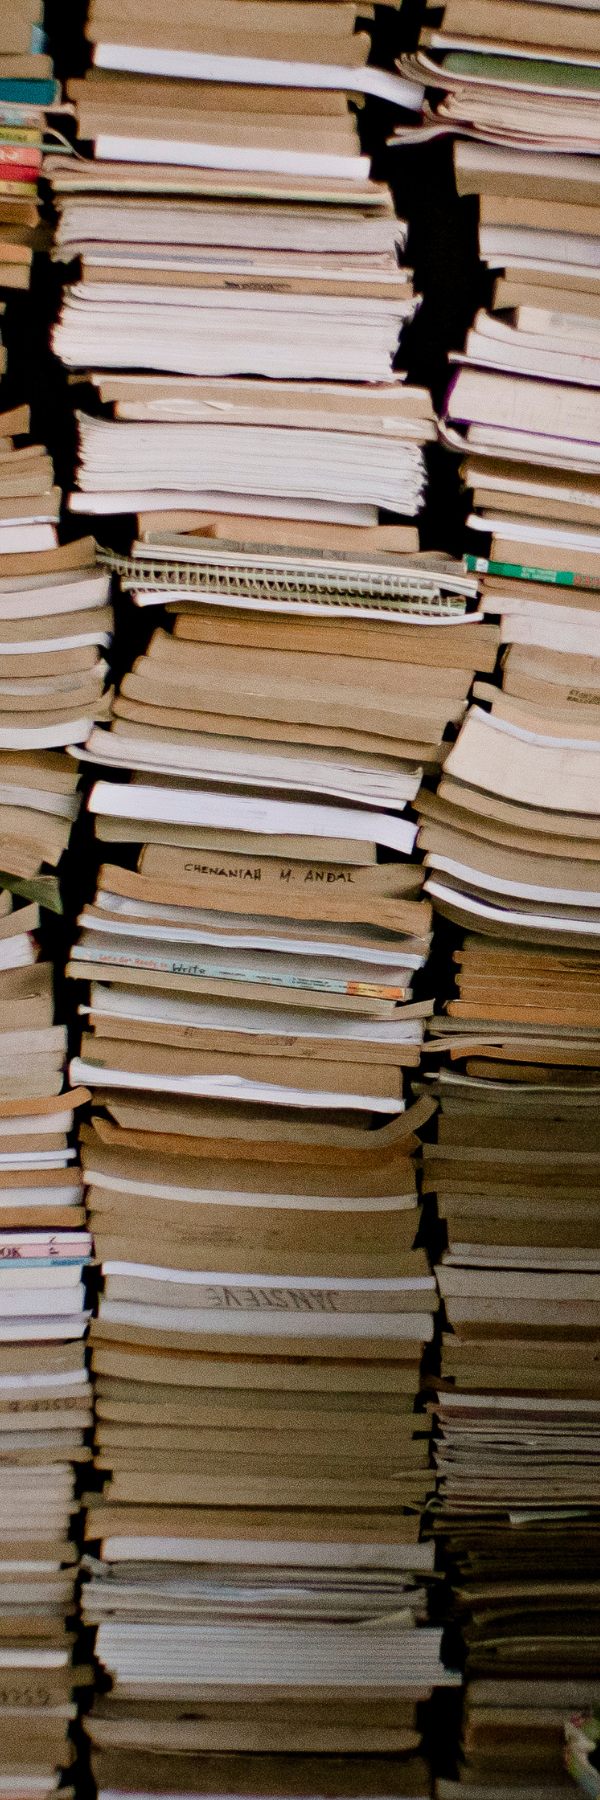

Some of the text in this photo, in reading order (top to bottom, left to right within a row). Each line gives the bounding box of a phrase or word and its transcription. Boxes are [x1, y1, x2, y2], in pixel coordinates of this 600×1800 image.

[184, 862, 261, 881] CHENANIAH
[304, 869, 356, 883] ANDAL
[134, 958, 157, 968] Ready
[172, 963, 206, 975] Write
[0, 1246, 21, 1259] OK
[205, 1285, 339, 1311] JANSTEVE
